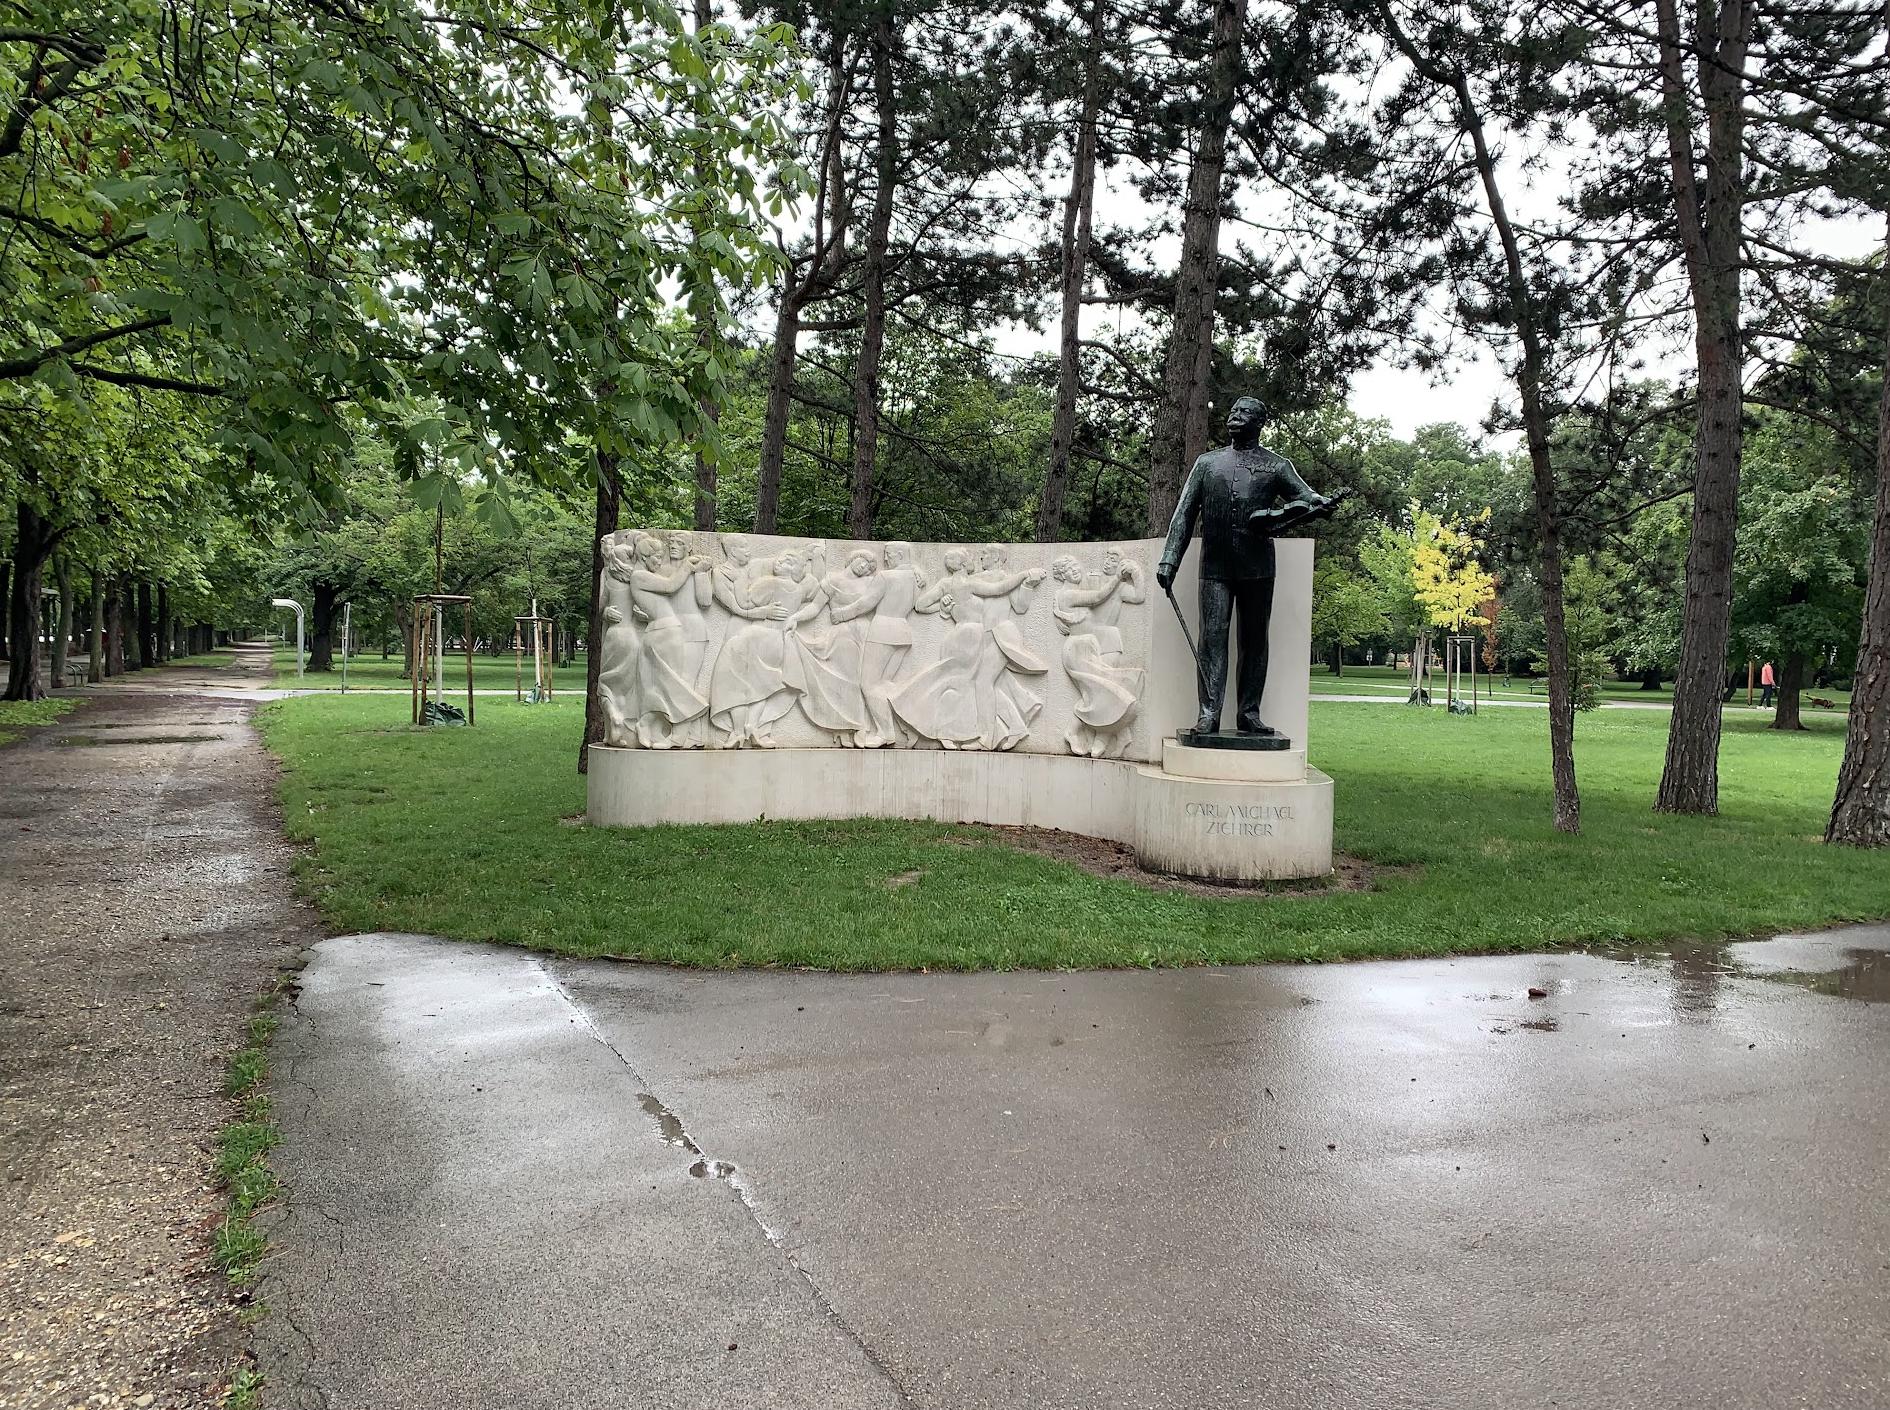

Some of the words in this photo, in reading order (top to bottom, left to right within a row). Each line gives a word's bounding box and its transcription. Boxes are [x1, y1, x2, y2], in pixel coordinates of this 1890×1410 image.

[1185, 802, 1220, 818] CARL
[1225, 805, 1295, 820] MICHAEL
[1206, 821, 1273, 837] ZIEHRER
